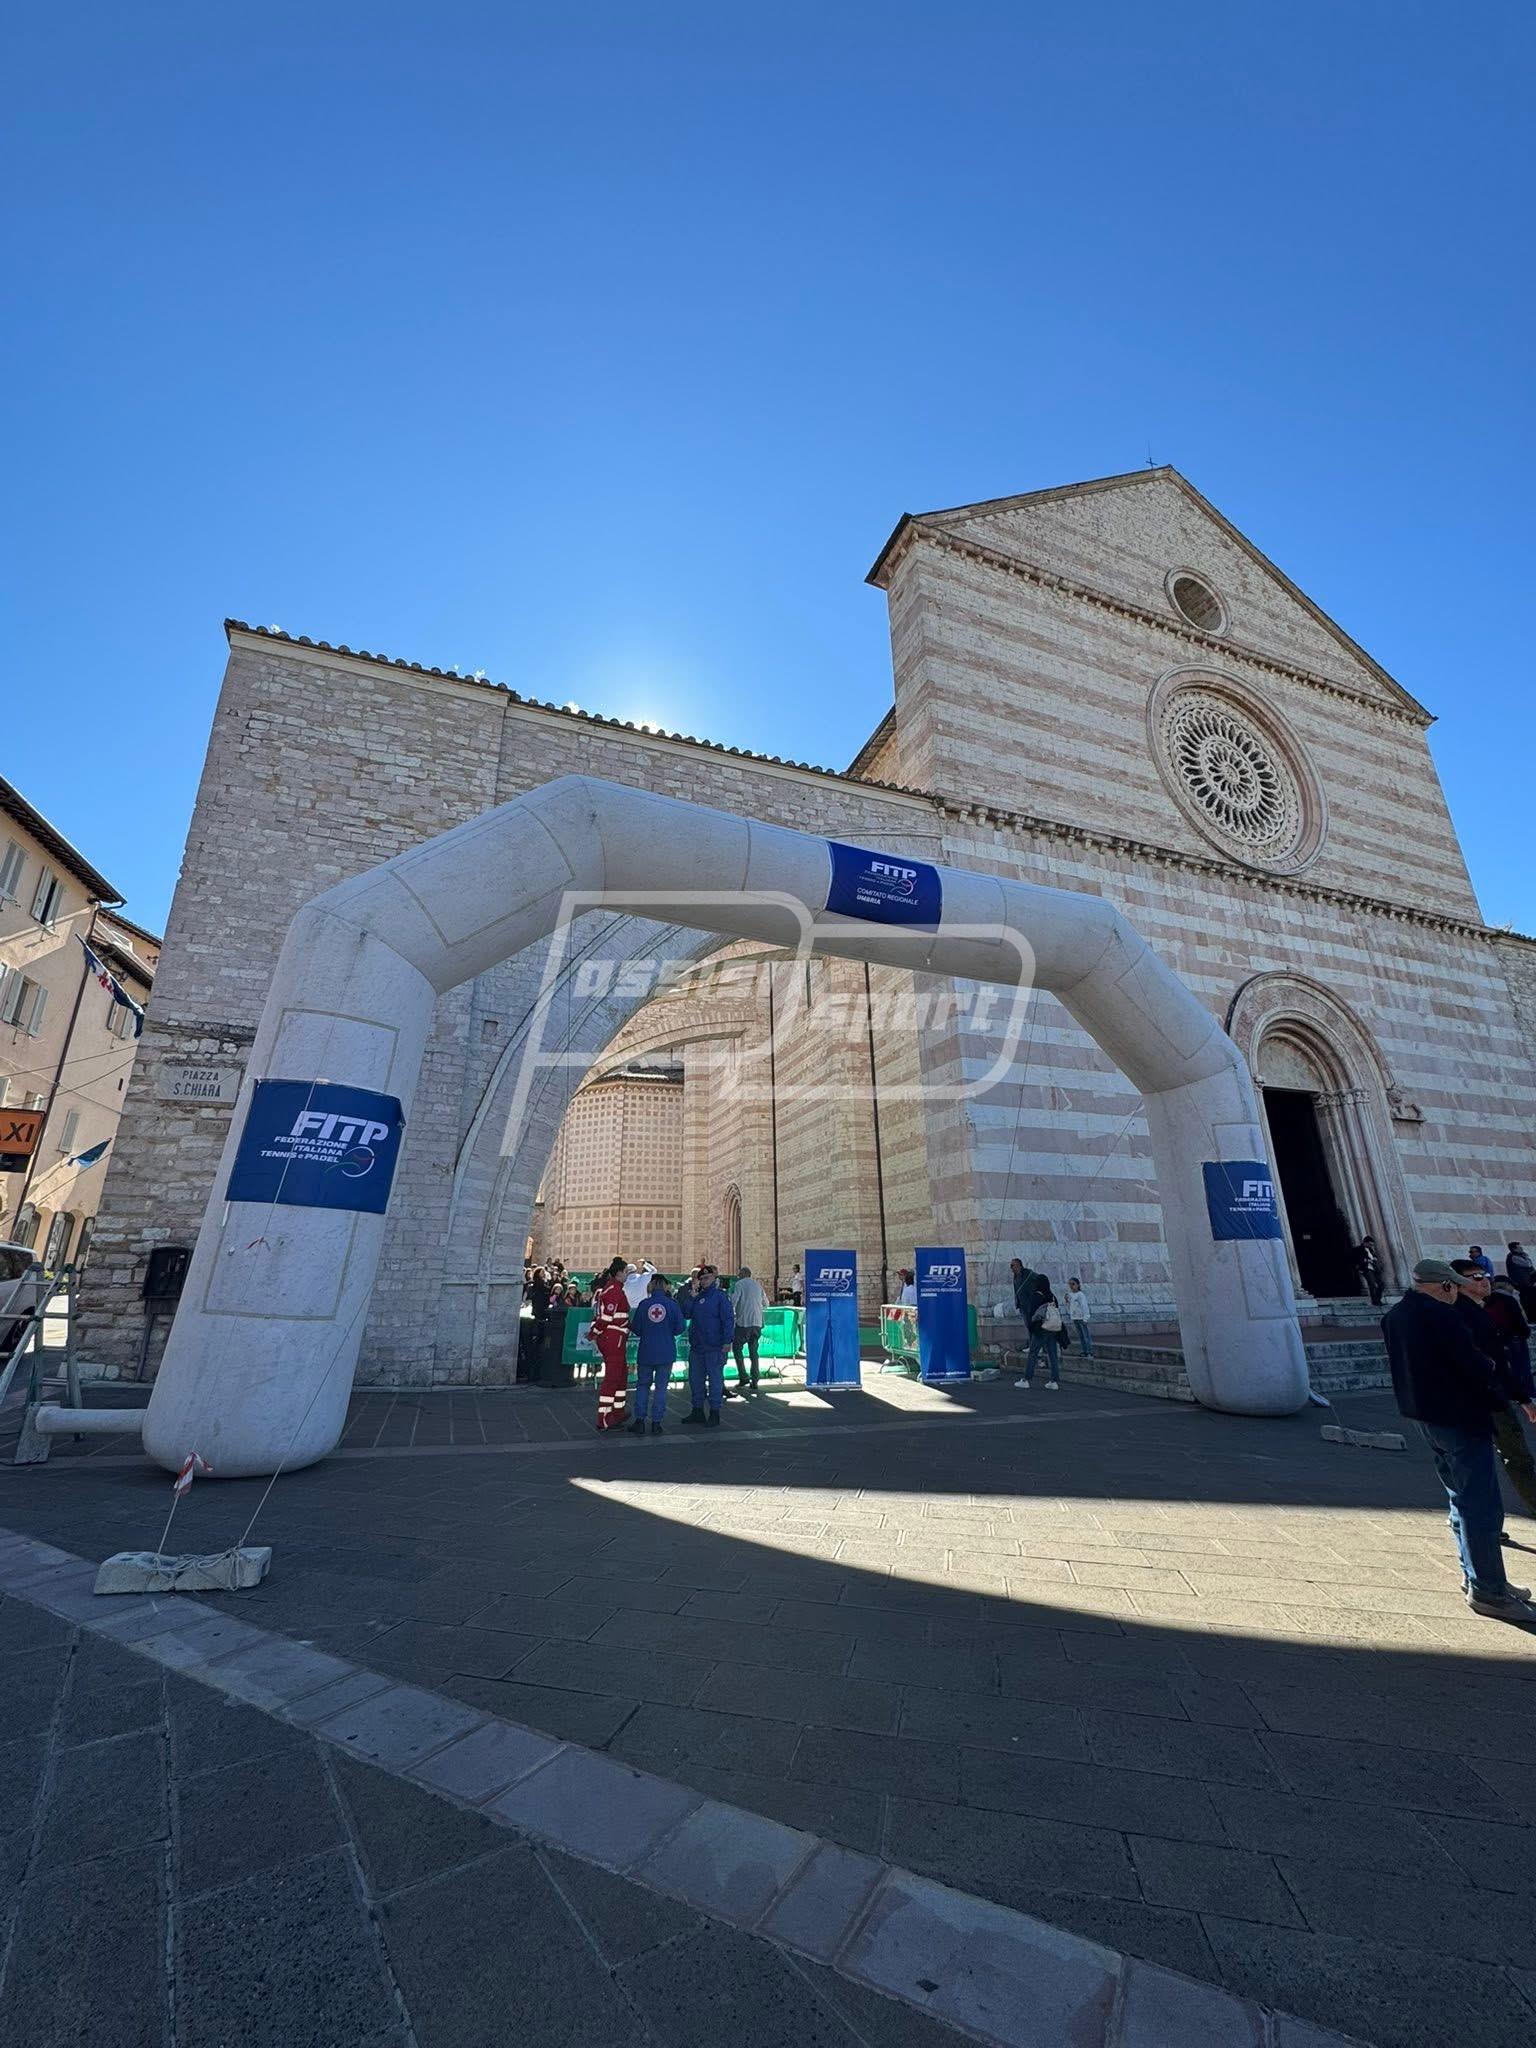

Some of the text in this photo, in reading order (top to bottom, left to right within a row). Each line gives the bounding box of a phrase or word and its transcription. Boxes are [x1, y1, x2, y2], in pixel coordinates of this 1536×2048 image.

[871, 861, 917, 879] FITP
[856, 887, 887, 899] COMITATO
[182, 1070, 219, 1081] PIAZZA
[0, 1121, 35, 1142] XI
[289, 1110, 389, 1145] FITP
[273, 1135, 349, 1150] FEDERAZIONE
[260, 1150, 297, 1160] TENNIS
[303, 1152, 340, 1164] PADEL
[294, 1144, 343, 1157] ITALIANA
[819, 1268, 853, 1279] FITP
[929, 1265, 961, 1275] FITP
